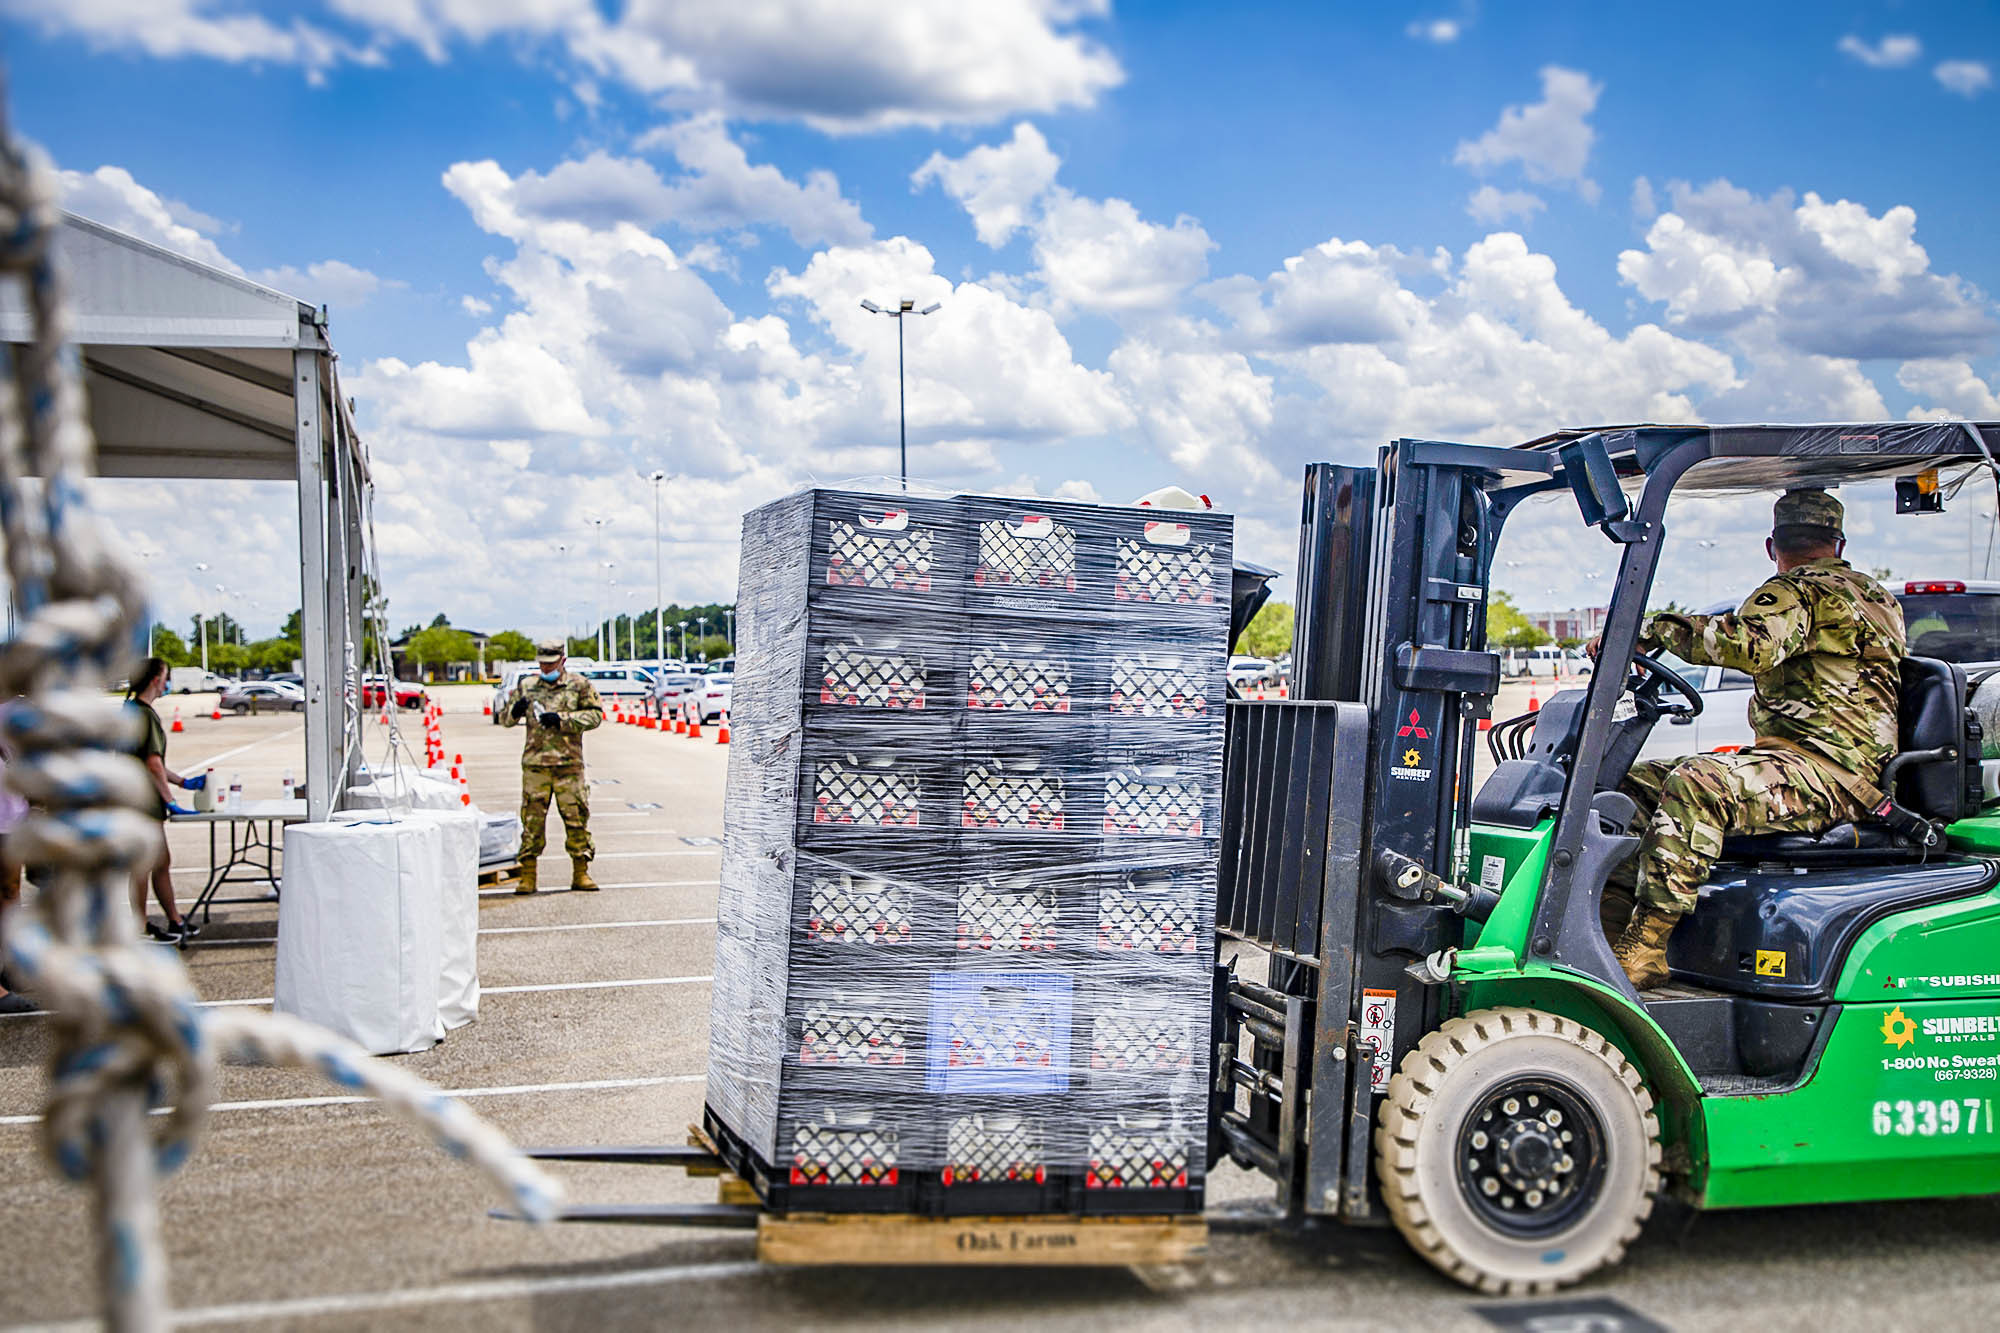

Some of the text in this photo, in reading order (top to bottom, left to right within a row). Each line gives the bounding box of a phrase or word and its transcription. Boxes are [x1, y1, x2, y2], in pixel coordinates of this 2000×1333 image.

[1391, 767, 1431, 778] SUNBELT
[1898, 974, 2000, 988] MTSUBISHI
[1935, 1034, 1995, 1042] RENTALS
[1881, 1057, 1925, 1070] 1-800
[1927, 1056, 1949, 1069] No
[1934, 1068, 1997, 1081] (667-9328)
[956, 1230, 1078, 1251] Oak Farms
